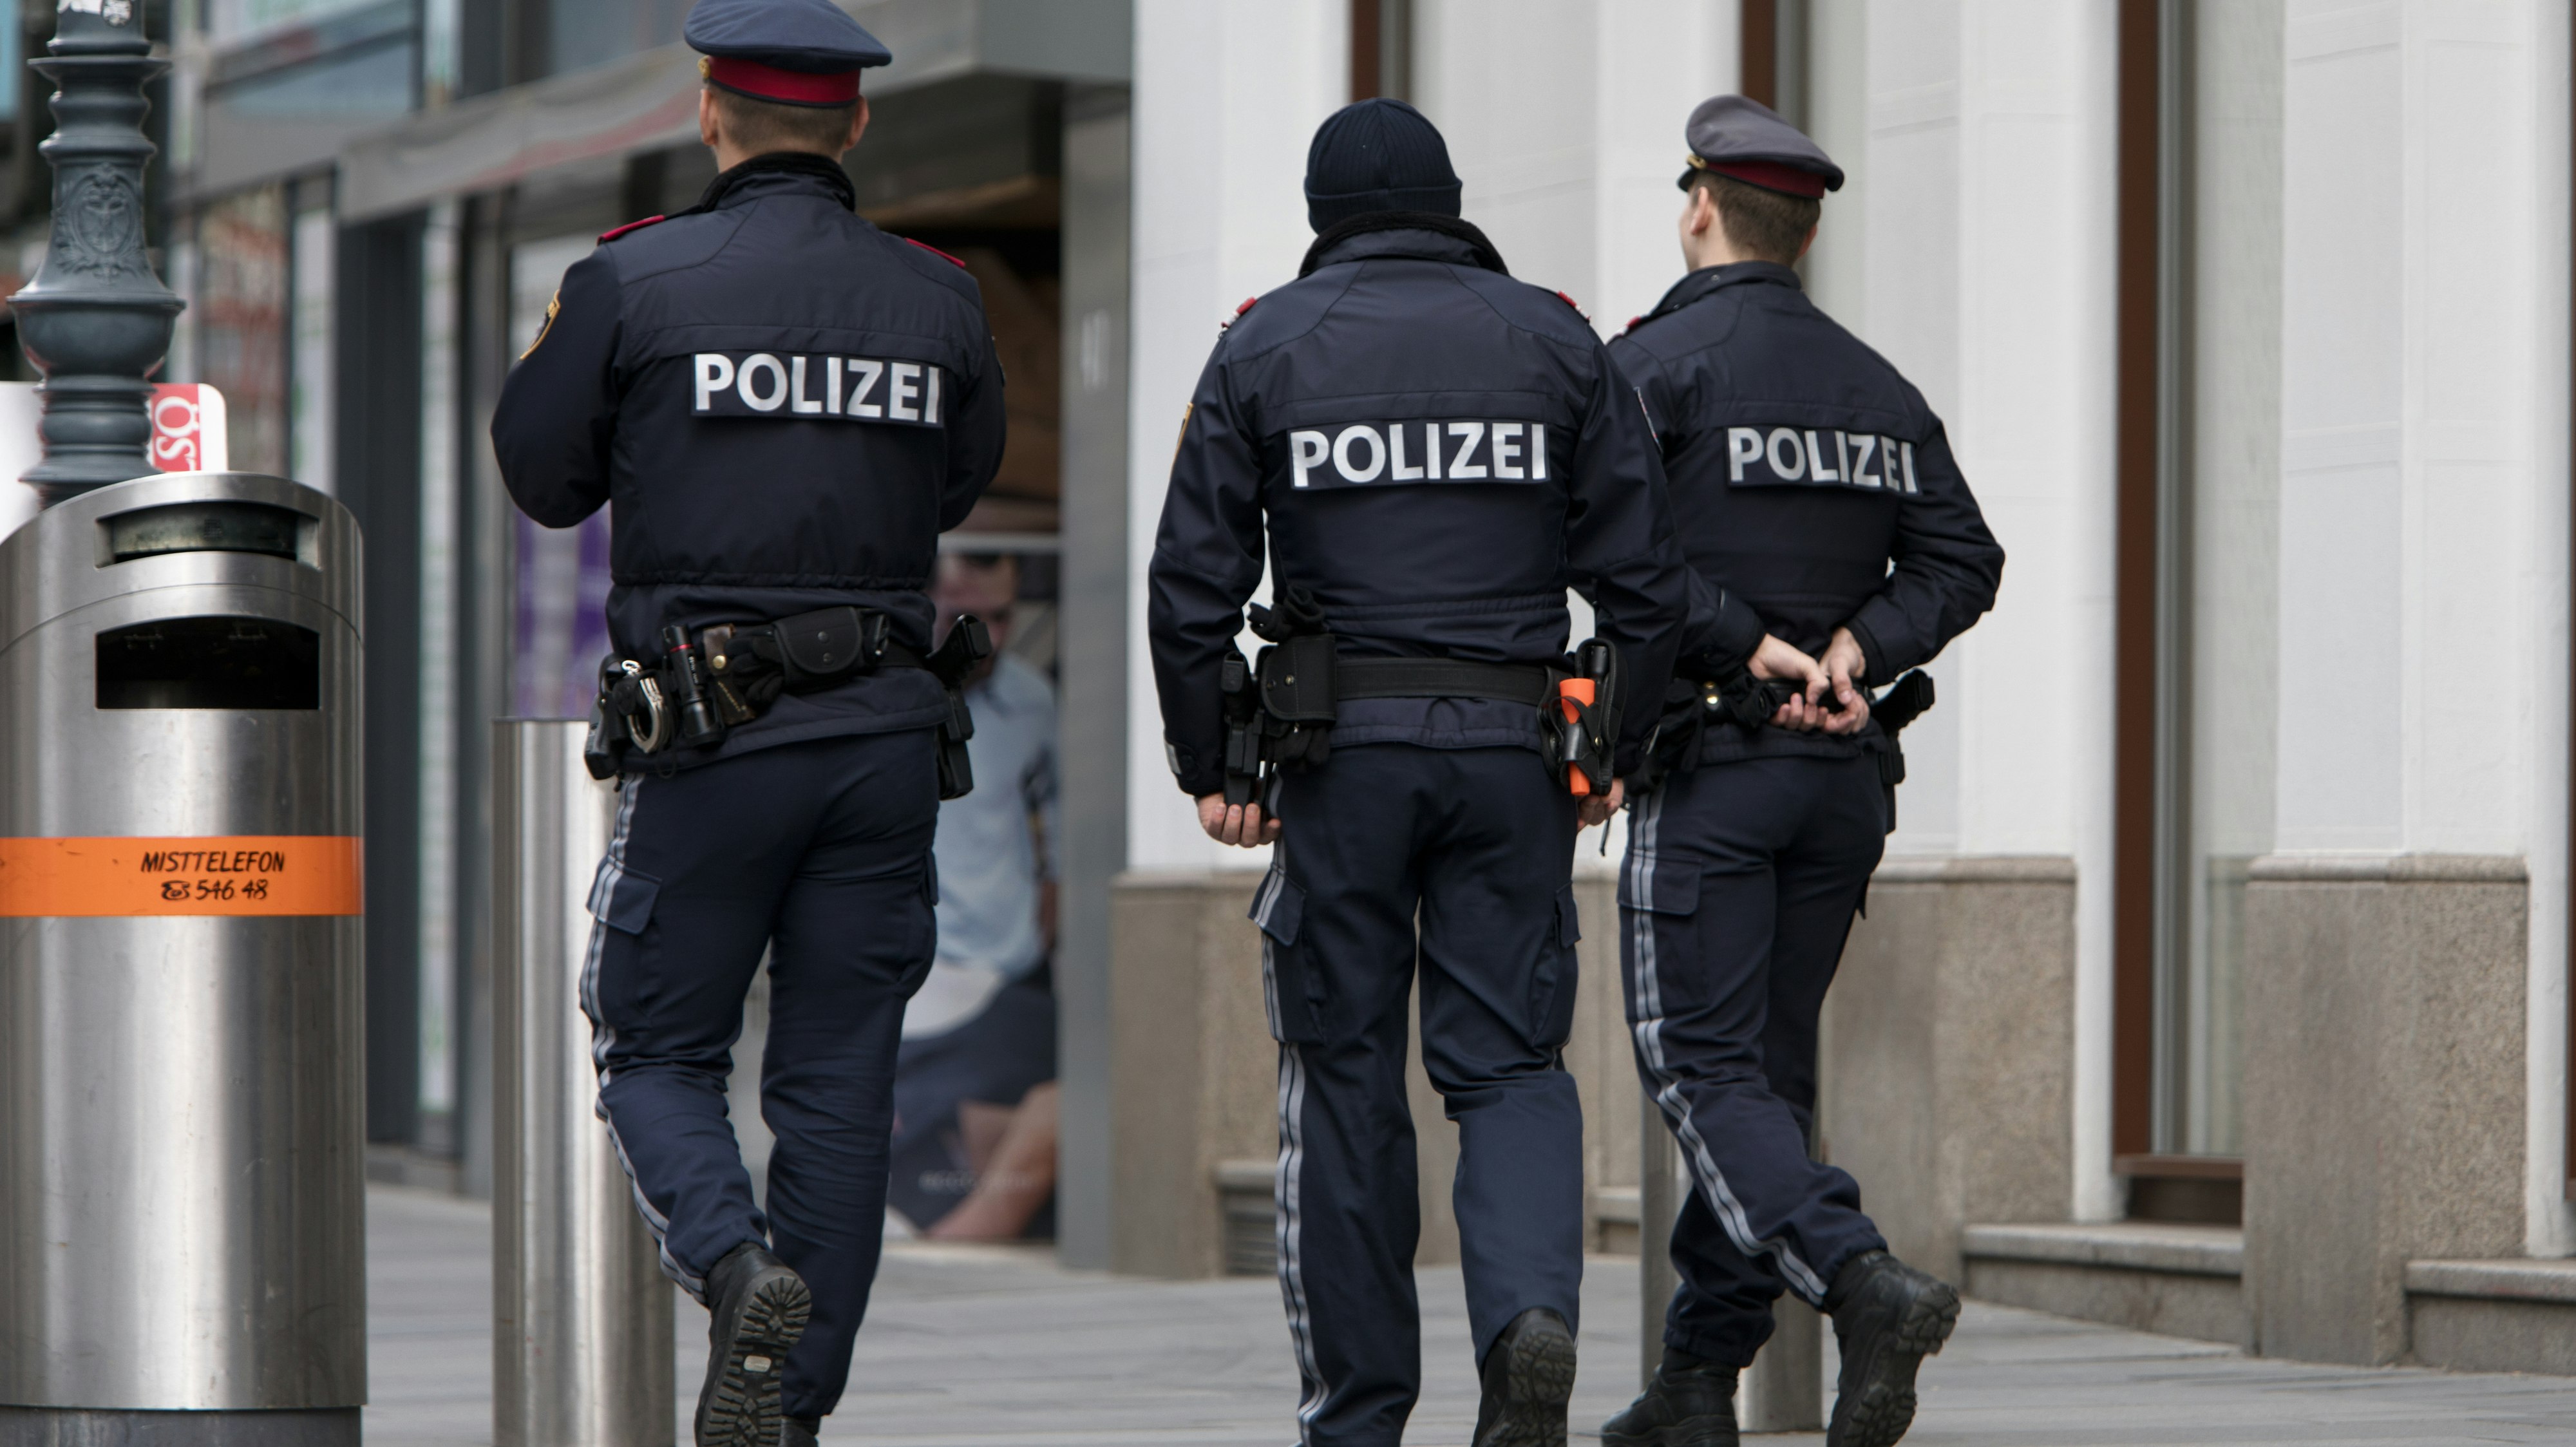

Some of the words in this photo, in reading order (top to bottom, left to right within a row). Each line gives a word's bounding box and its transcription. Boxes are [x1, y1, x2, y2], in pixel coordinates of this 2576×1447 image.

[694, 352, 940, 424] POLIZEI
[154, 395, 200, 471] ÖS
[1290, 422, 1547, 487] POLIZEI
[1727, 427, 1918, 494] POLIZEI
[140, 850, 285, 873] MISTTELEFON
[195, 879, 234, 900] 546
[242, 879, 268, 900] 48
